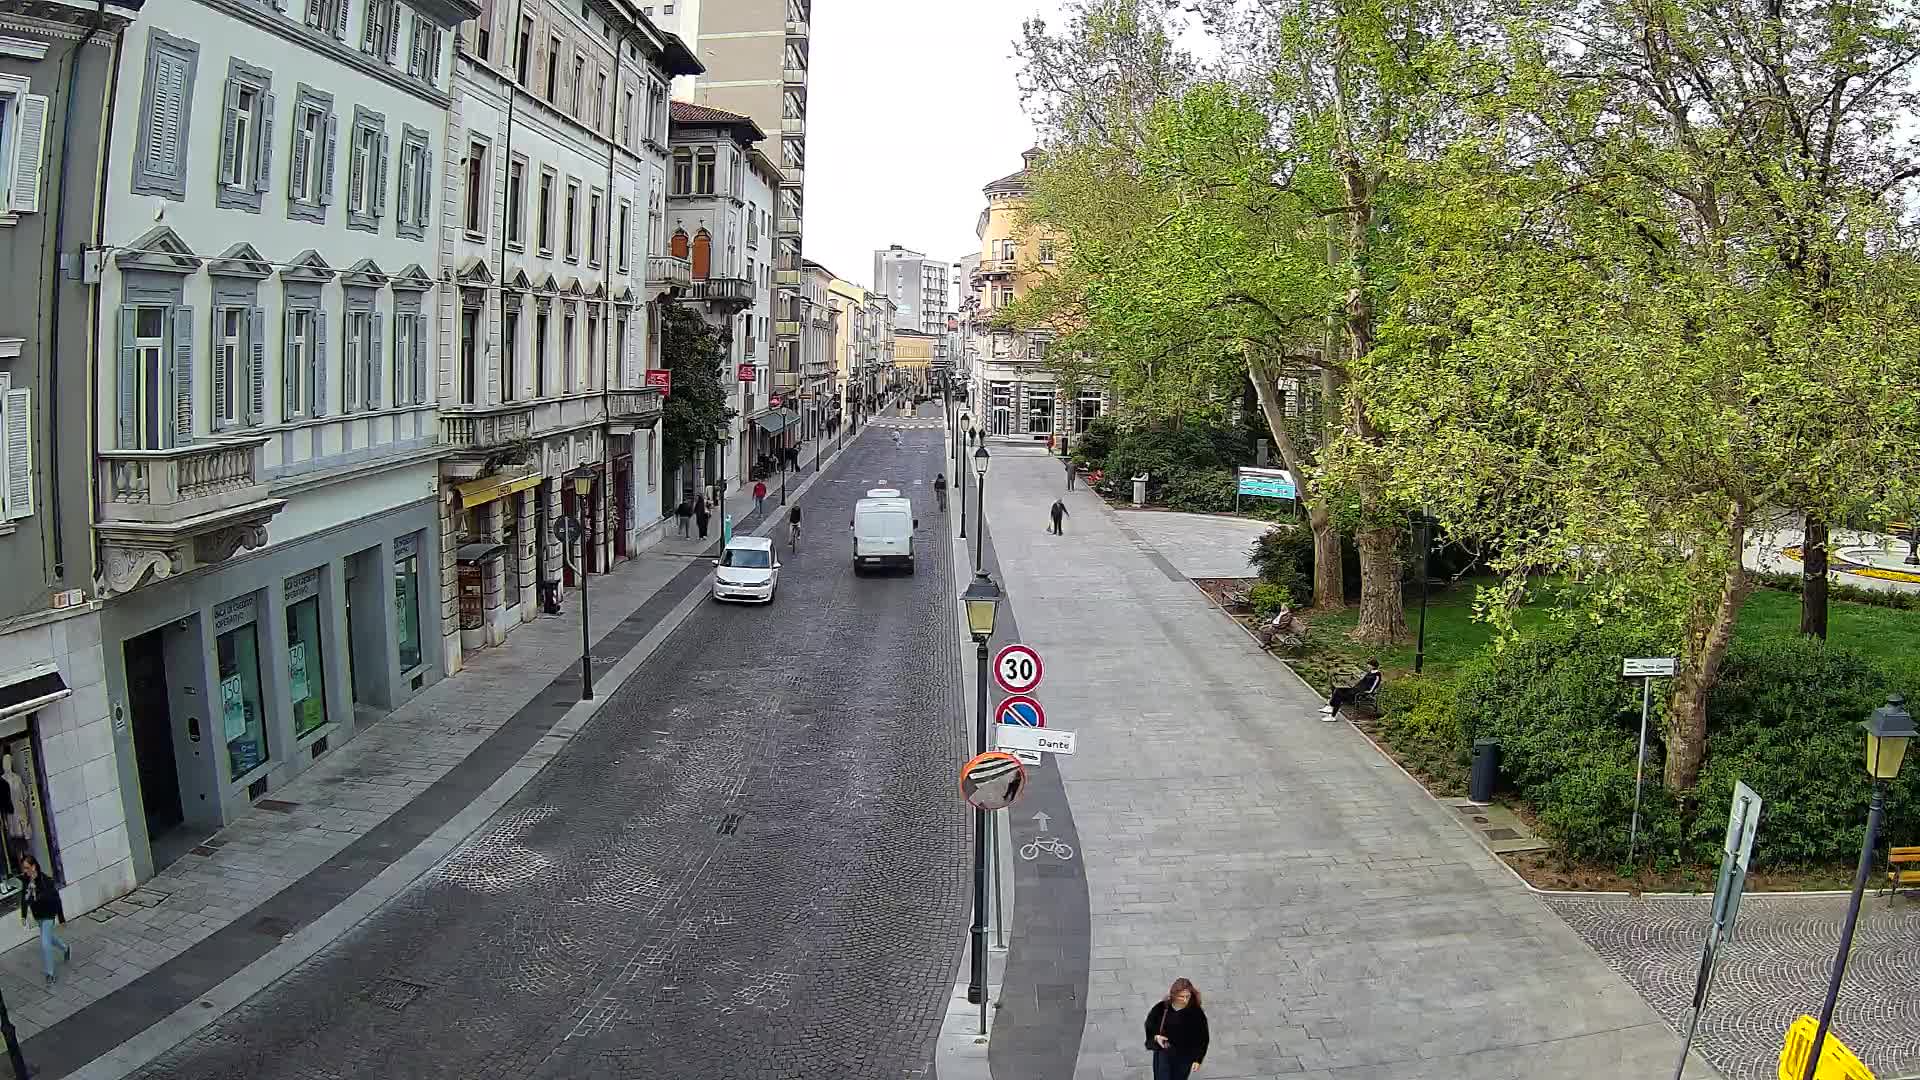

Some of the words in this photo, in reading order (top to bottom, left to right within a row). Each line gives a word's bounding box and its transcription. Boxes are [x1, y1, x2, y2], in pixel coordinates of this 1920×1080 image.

[1005, 658, 1033, 680] 30
[221, 677, 241, 700] 130
[1038, 738, 1070, 749] Dante
